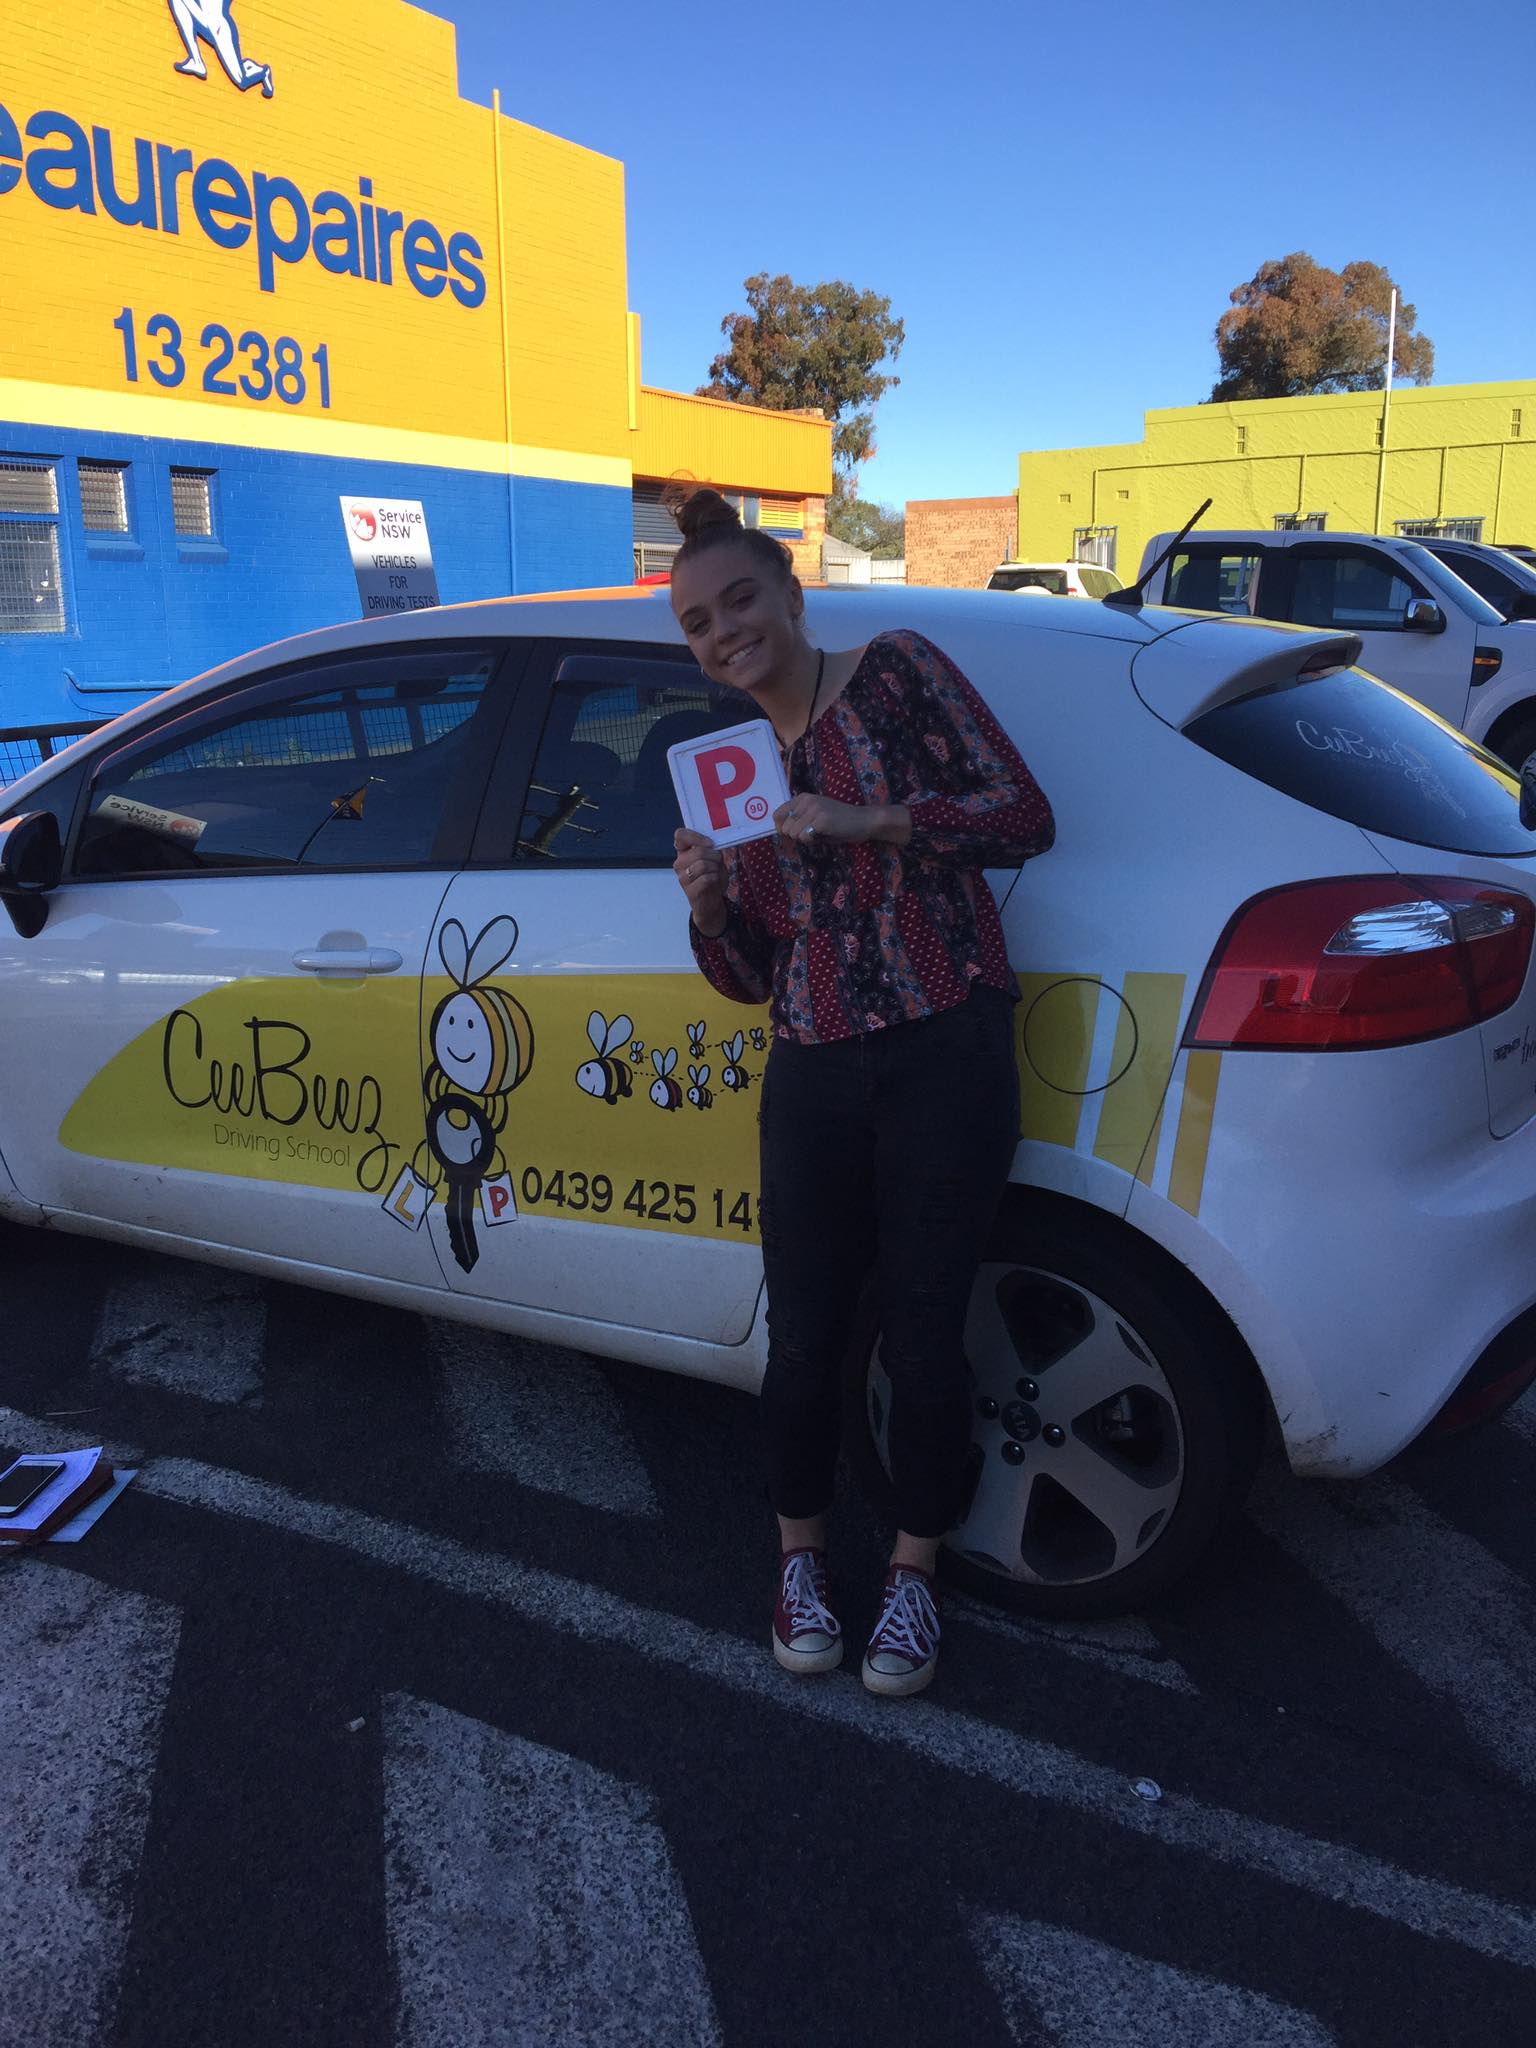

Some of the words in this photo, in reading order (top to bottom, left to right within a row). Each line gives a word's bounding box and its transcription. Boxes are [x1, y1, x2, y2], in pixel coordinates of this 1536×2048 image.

[113, 307, 186, 388] 13
[200, 323, 330, 409] 2381
[378, 508, 422, 524] Service
[381, 525, 411, 539] NSW
[371, 554, 417, 569] VEHICLES
[389, 575, 408, 589] FOR
[367, 596, 406, 609] DRIVING
[407, 596, 436, 608] TESTS
[694, 745, 756, 831] P
[749, 802, 763, 814] 90
[214, 1123, 280, 1161] Driving
[286, 1135, 350, 1168] School
[393, 1180, 415, 1223] L
[488, 1185, 509, 1218] P
[521, 1166, 613, 1213] 0439
[623, 1178, 697, 1224] 425
[713, 1188, 761, 1232] 14
